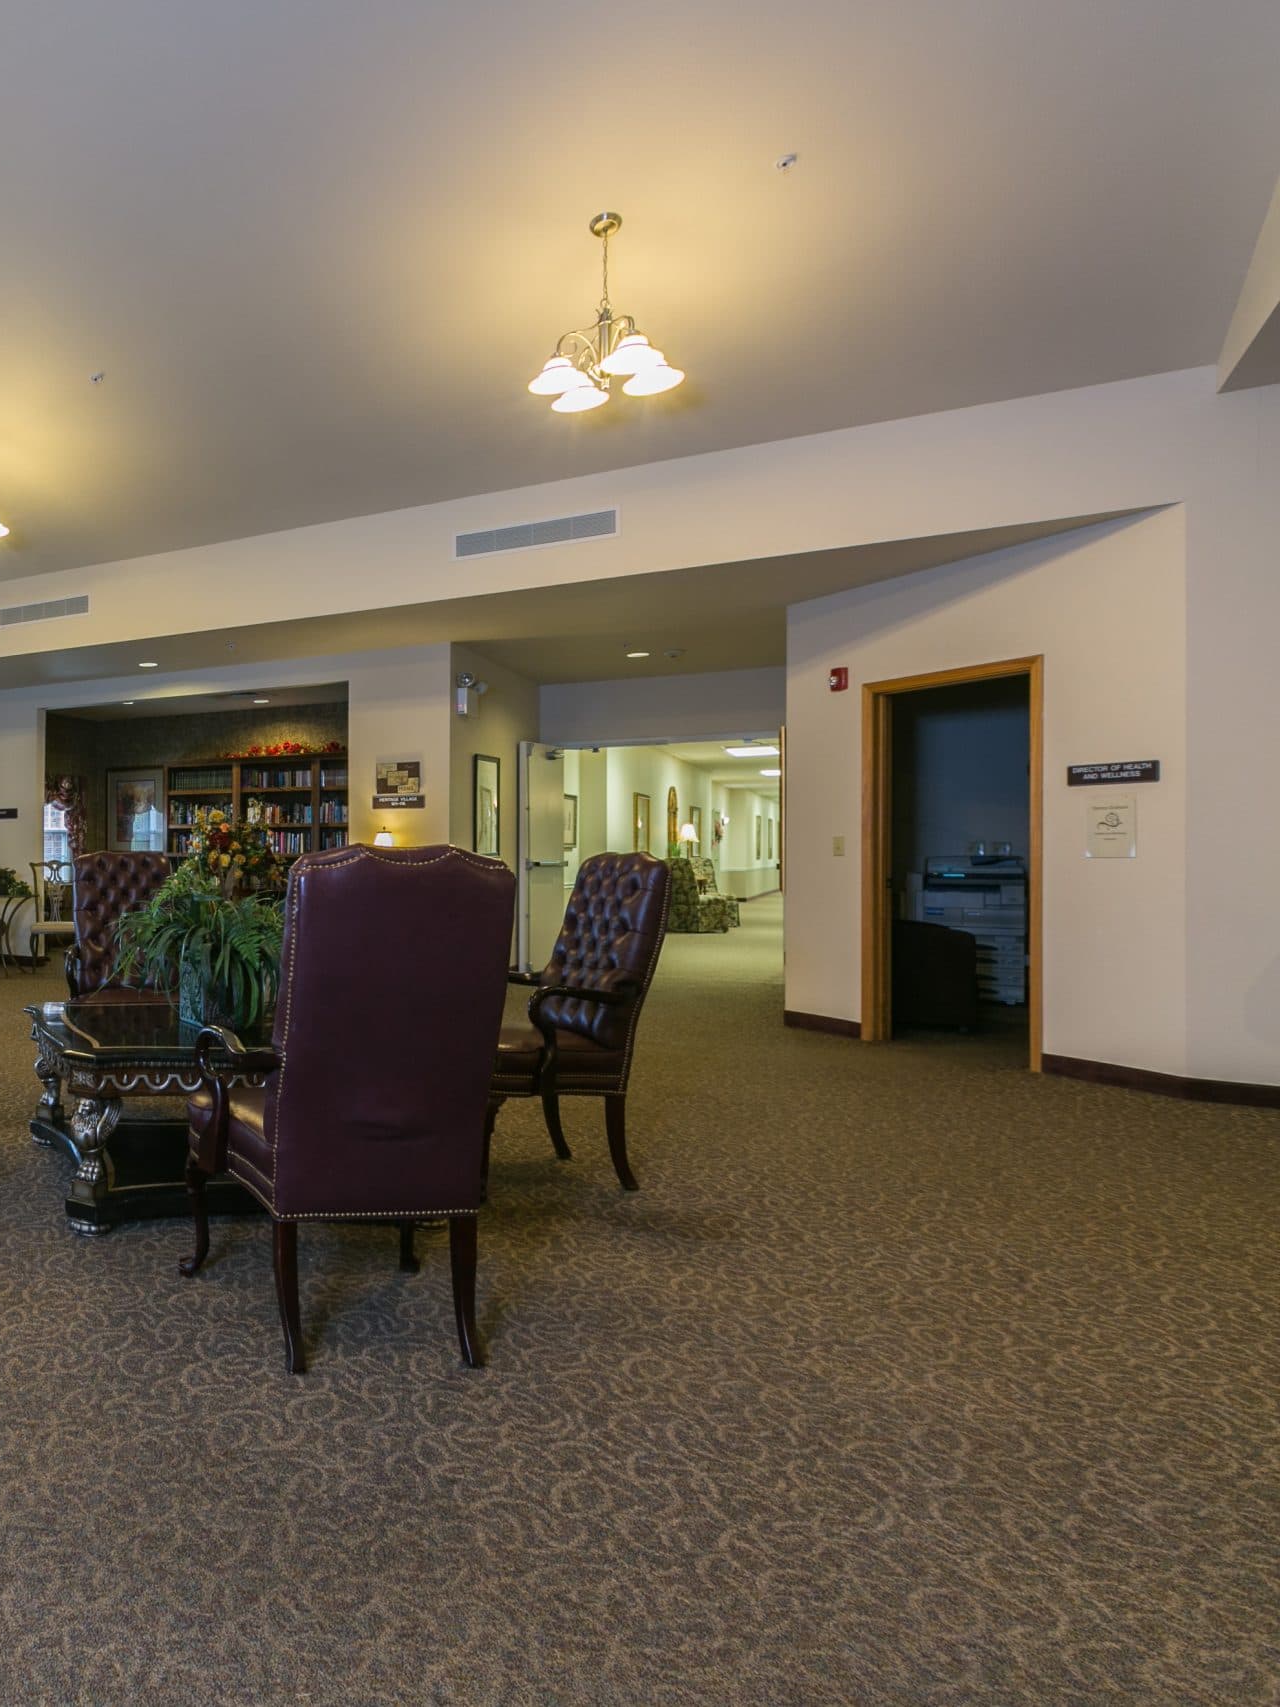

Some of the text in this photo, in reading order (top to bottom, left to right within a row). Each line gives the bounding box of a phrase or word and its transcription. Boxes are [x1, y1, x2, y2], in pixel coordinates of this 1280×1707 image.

[1072, 766, 1108, 774] DIRECTOR
[1123, 762, 1152, 770] HEALTH
[1100, 770, 1142, 779] WELLNESS
